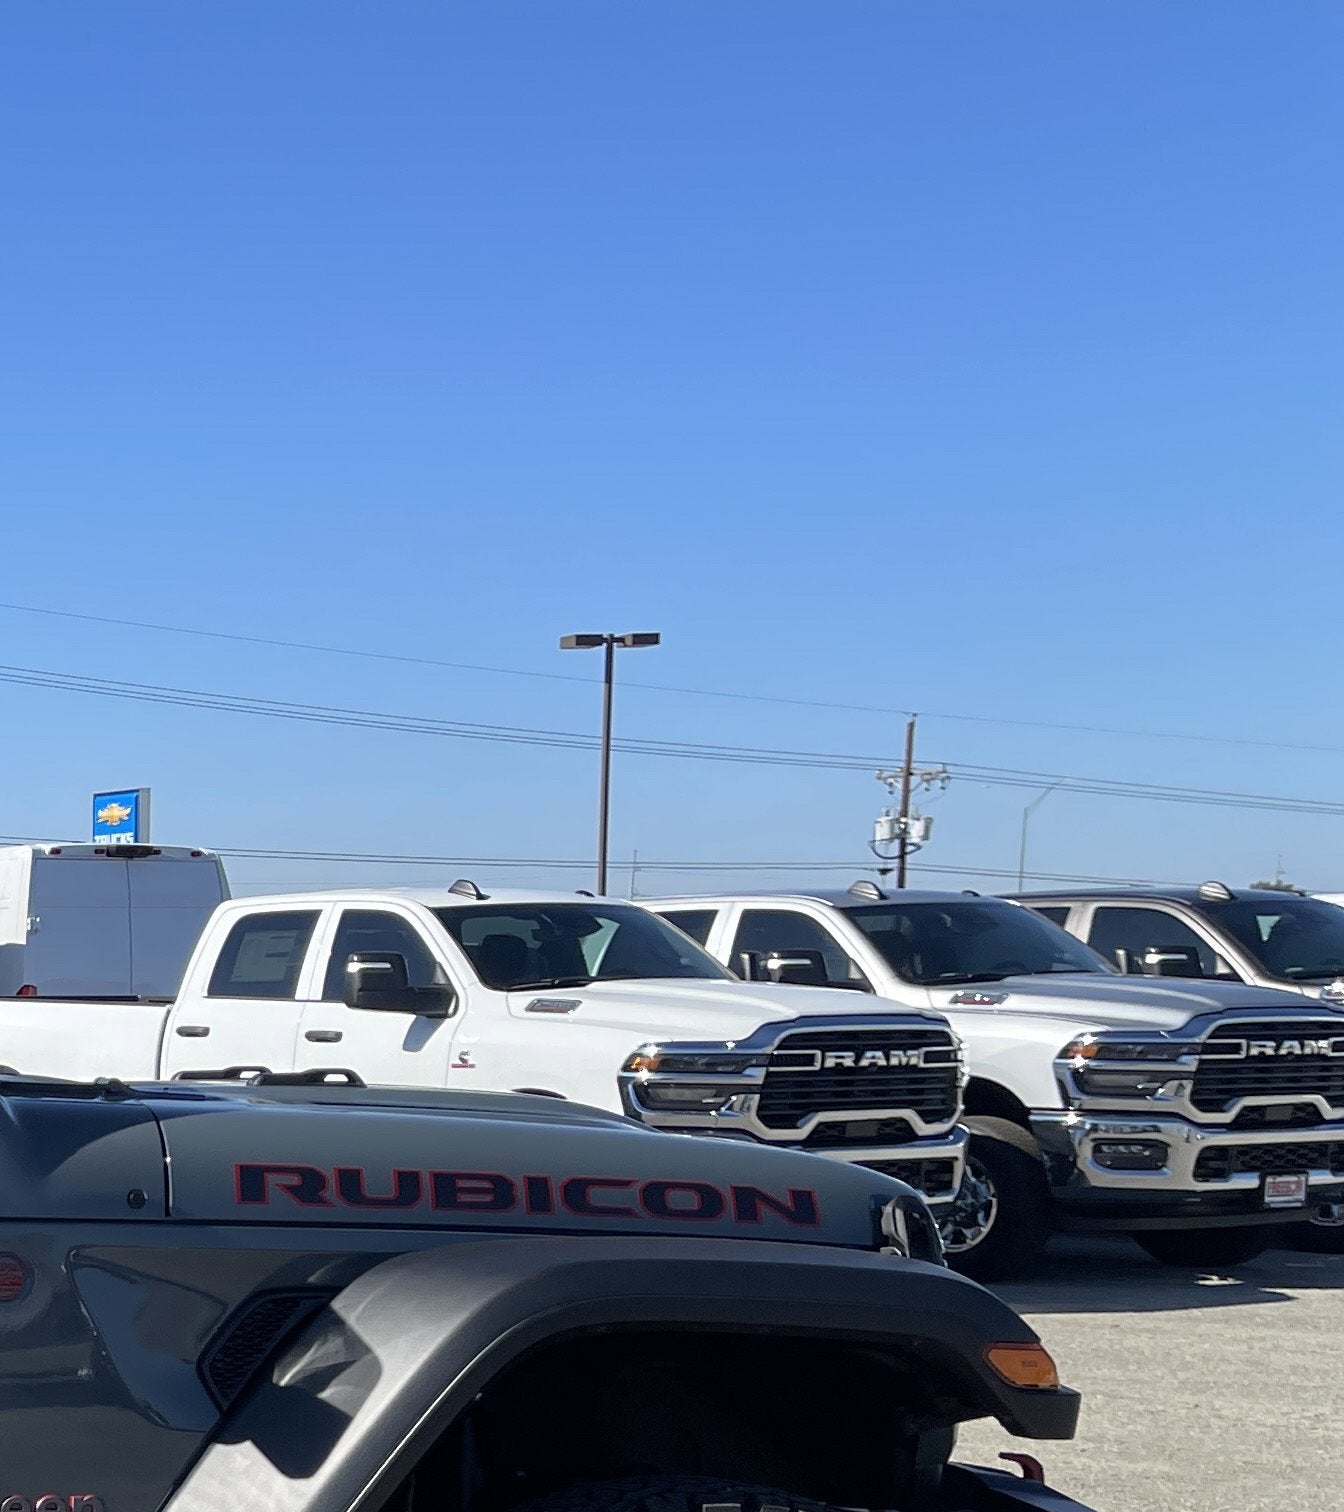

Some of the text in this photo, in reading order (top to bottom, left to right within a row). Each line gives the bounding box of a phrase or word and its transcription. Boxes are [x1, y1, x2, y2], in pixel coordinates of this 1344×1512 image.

[1249, 1040, 1330, 1056] RAM
[824, 1049, 920, 1068] RAM
[233, 1162, 821, 1228] RUBICON
